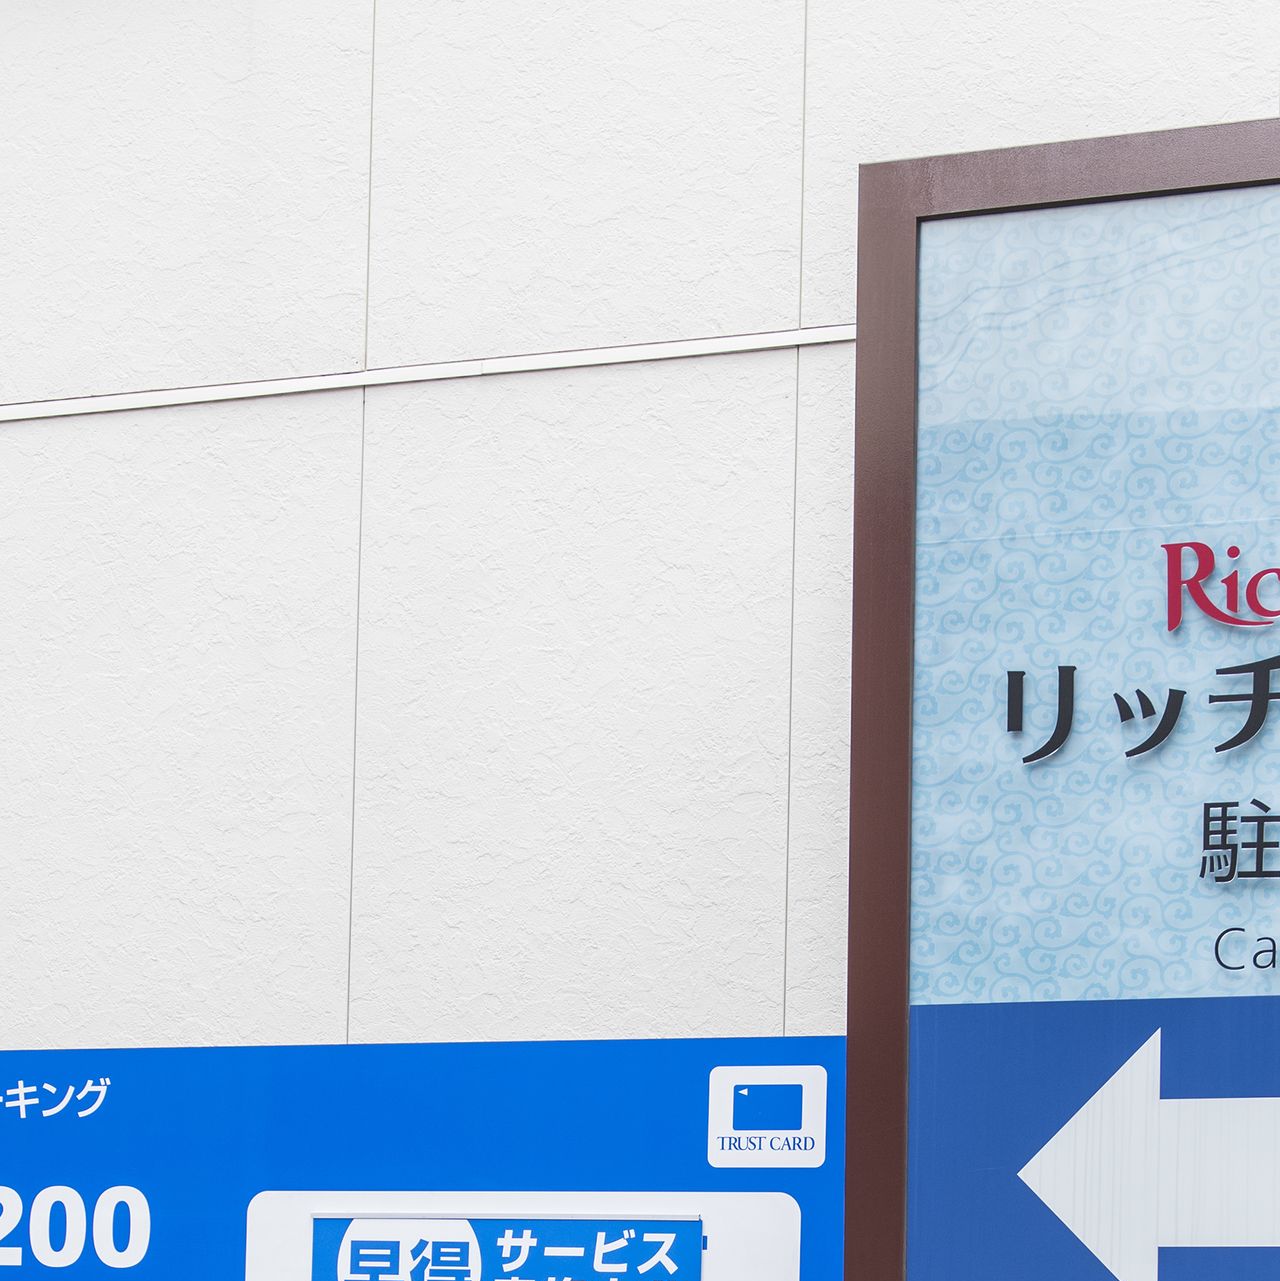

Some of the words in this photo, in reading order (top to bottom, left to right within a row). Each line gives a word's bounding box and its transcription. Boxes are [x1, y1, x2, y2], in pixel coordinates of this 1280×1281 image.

[717, 1135, 767, 1151] TRUST
[769, 1135, 816, 1152] CARD
[496, 1228, 678, 1276] サービス
